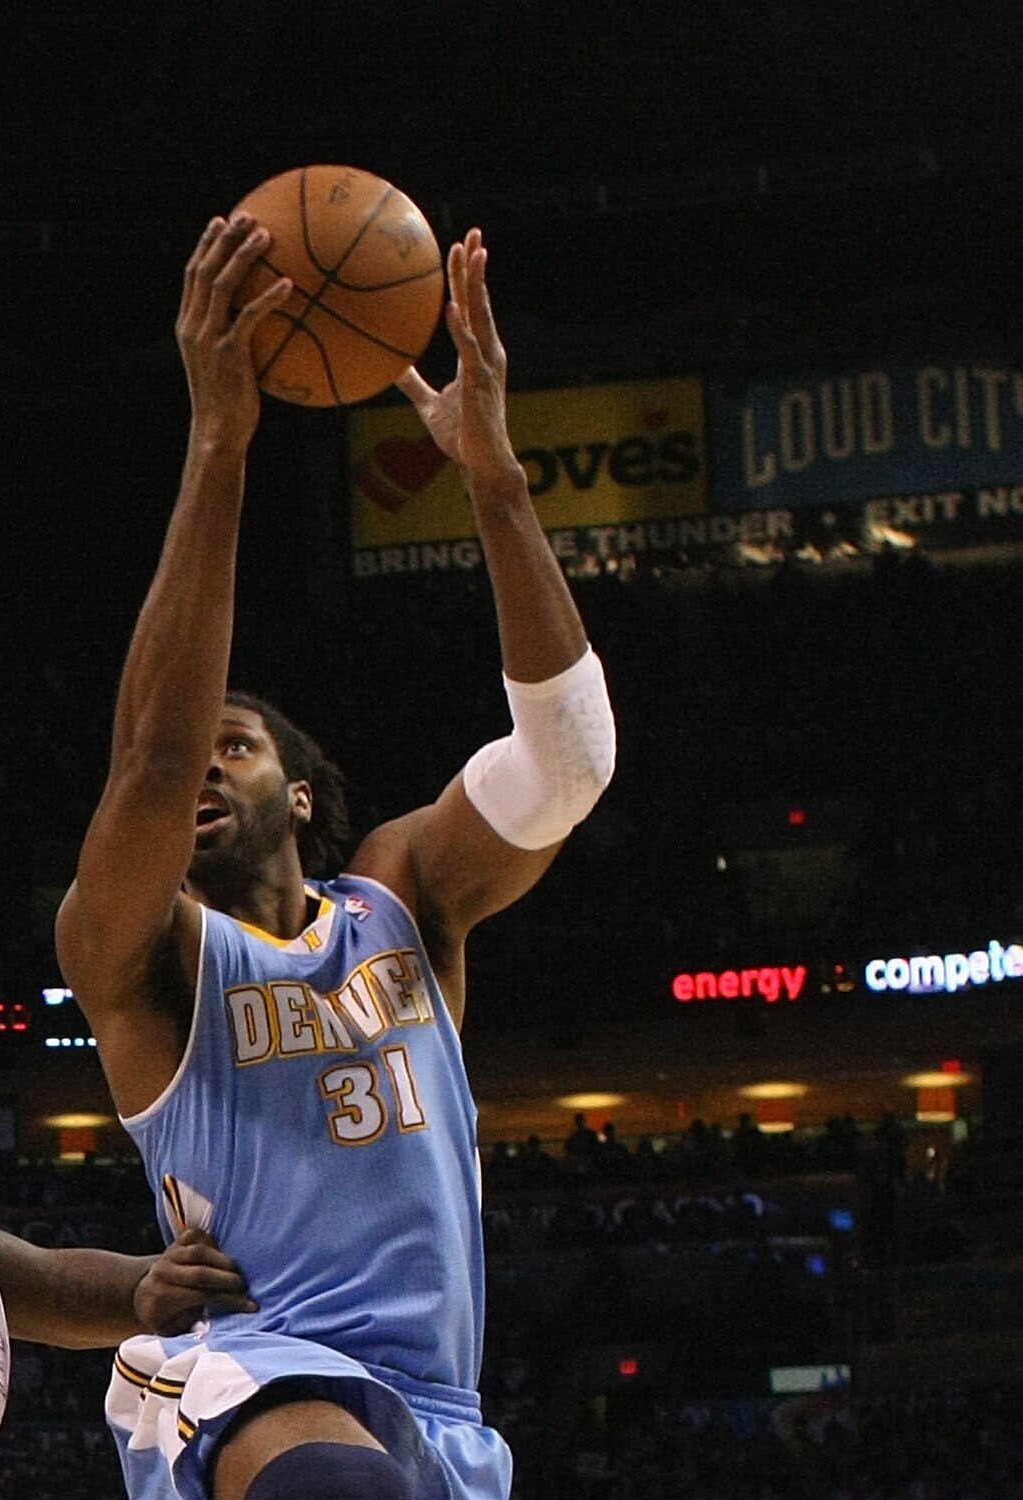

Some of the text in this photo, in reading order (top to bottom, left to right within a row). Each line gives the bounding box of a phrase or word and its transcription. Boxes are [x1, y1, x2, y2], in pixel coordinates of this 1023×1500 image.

[743, 370, 896, 488] LOUD
[519, 431, 700, 496] oves
[354, 540, 478, 577] BRING
[591, 509, 795, 554] THUNDER
[672, 964, 811, 1004] energy
[318, 1043, 429, 1147] 31
